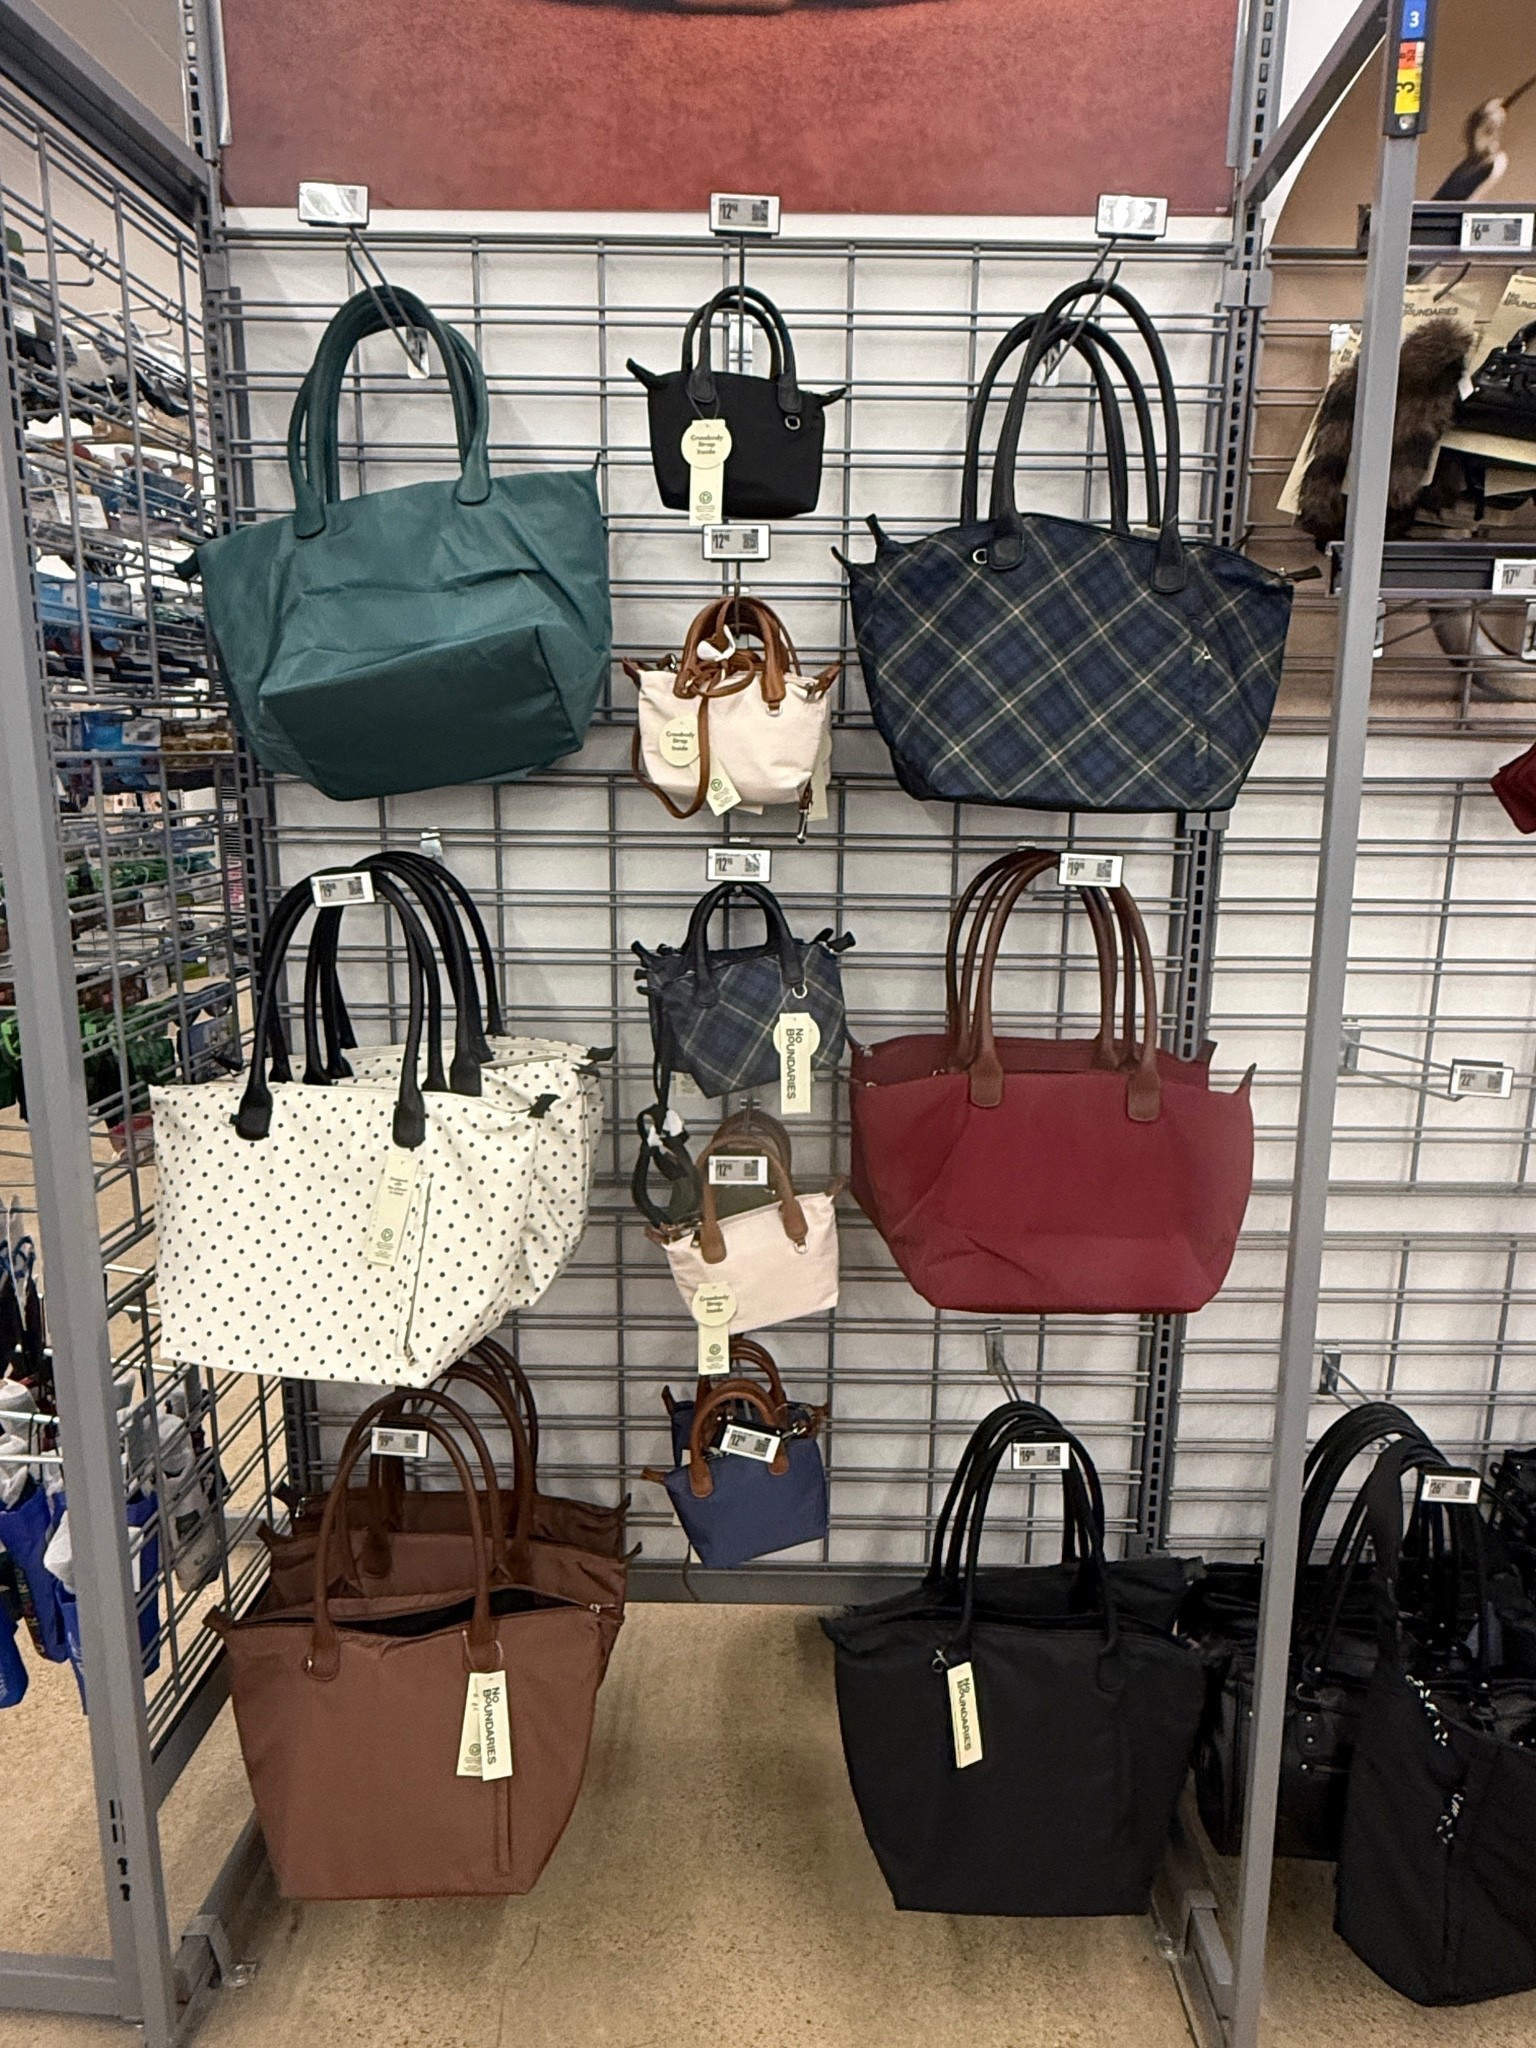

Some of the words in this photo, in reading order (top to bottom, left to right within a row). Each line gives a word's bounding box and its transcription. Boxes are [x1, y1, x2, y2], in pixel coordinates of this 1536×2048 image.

[1409, 10, 1419, 28] 3
[786, 1028, 796, 1099] BOUNDARIES
[483, 1689, 497, 1765] BOUNDARIES
[957, 1680, 972, 1751] BOUNDARIES
